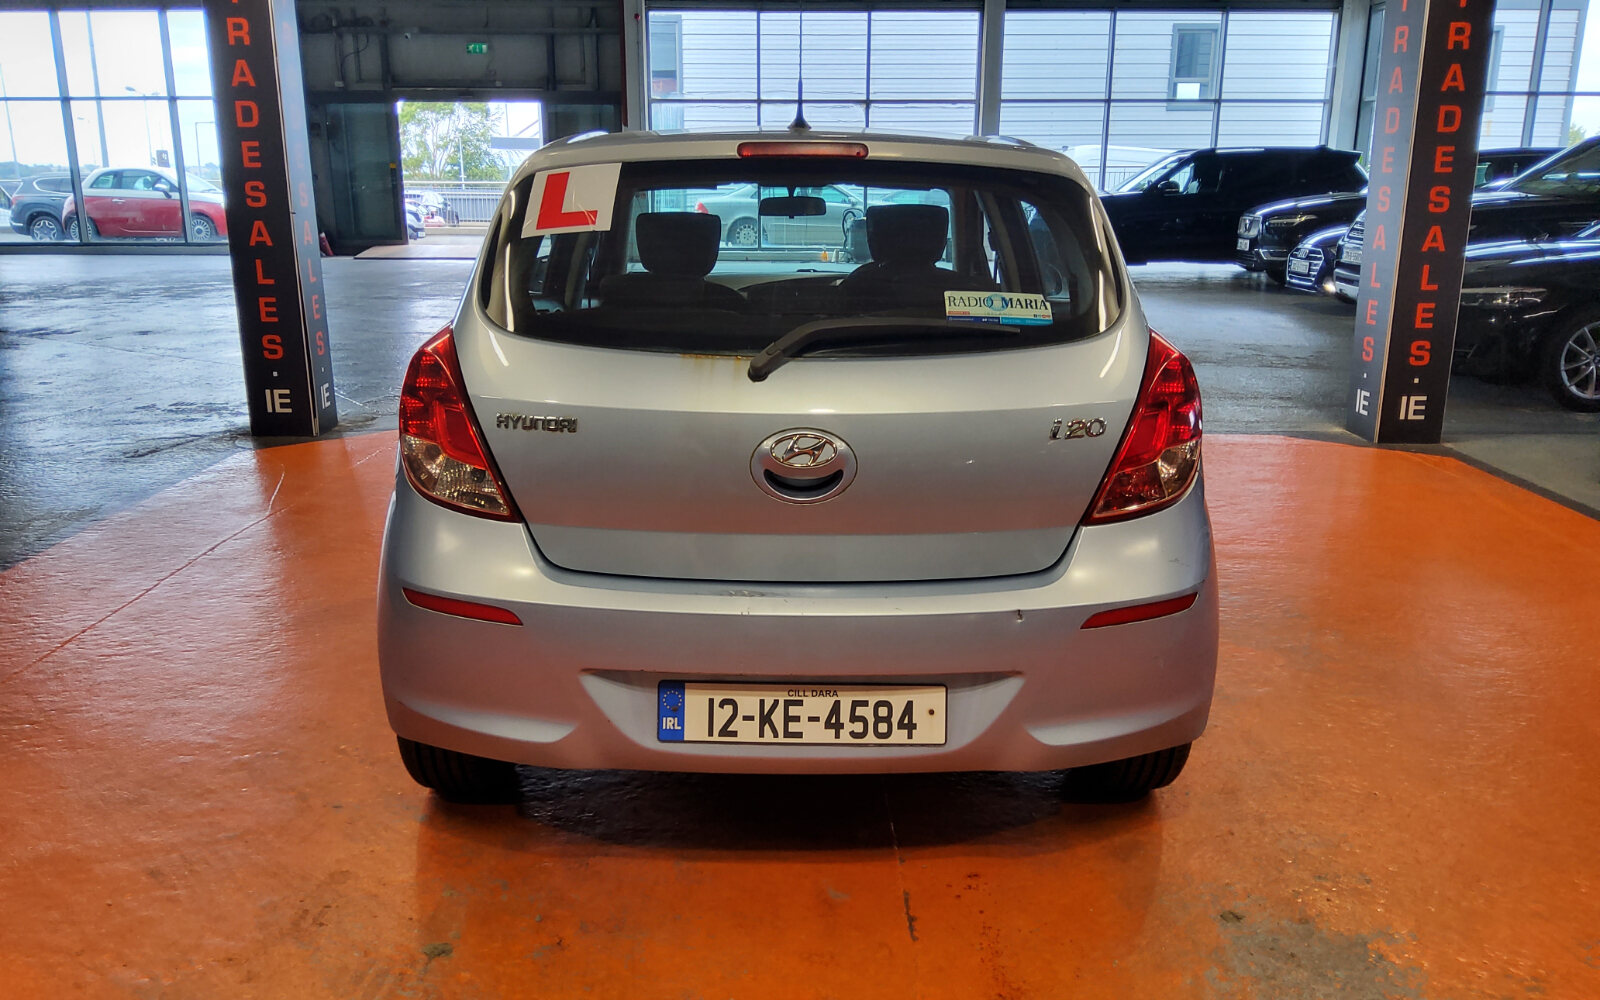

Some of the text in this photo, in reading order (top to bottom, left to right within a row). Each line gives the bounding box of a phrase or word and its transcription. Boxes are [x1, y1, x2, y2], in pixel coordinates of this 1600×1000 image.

[226, 0, 293, 414] RADESALES.IE
[536, 171, 598, 230] L
[1399, 0, 1472, 421] RADESALES.IE
[947, 295, 1049, 311] RADIO MARIA
[496, 412, 578, 434] HYUNDAI
[787, 689, 839, 698] CILL DARA
[662, 717, 681, 730] IRL
[707, 697, 918, 740] 12-KE-4584
